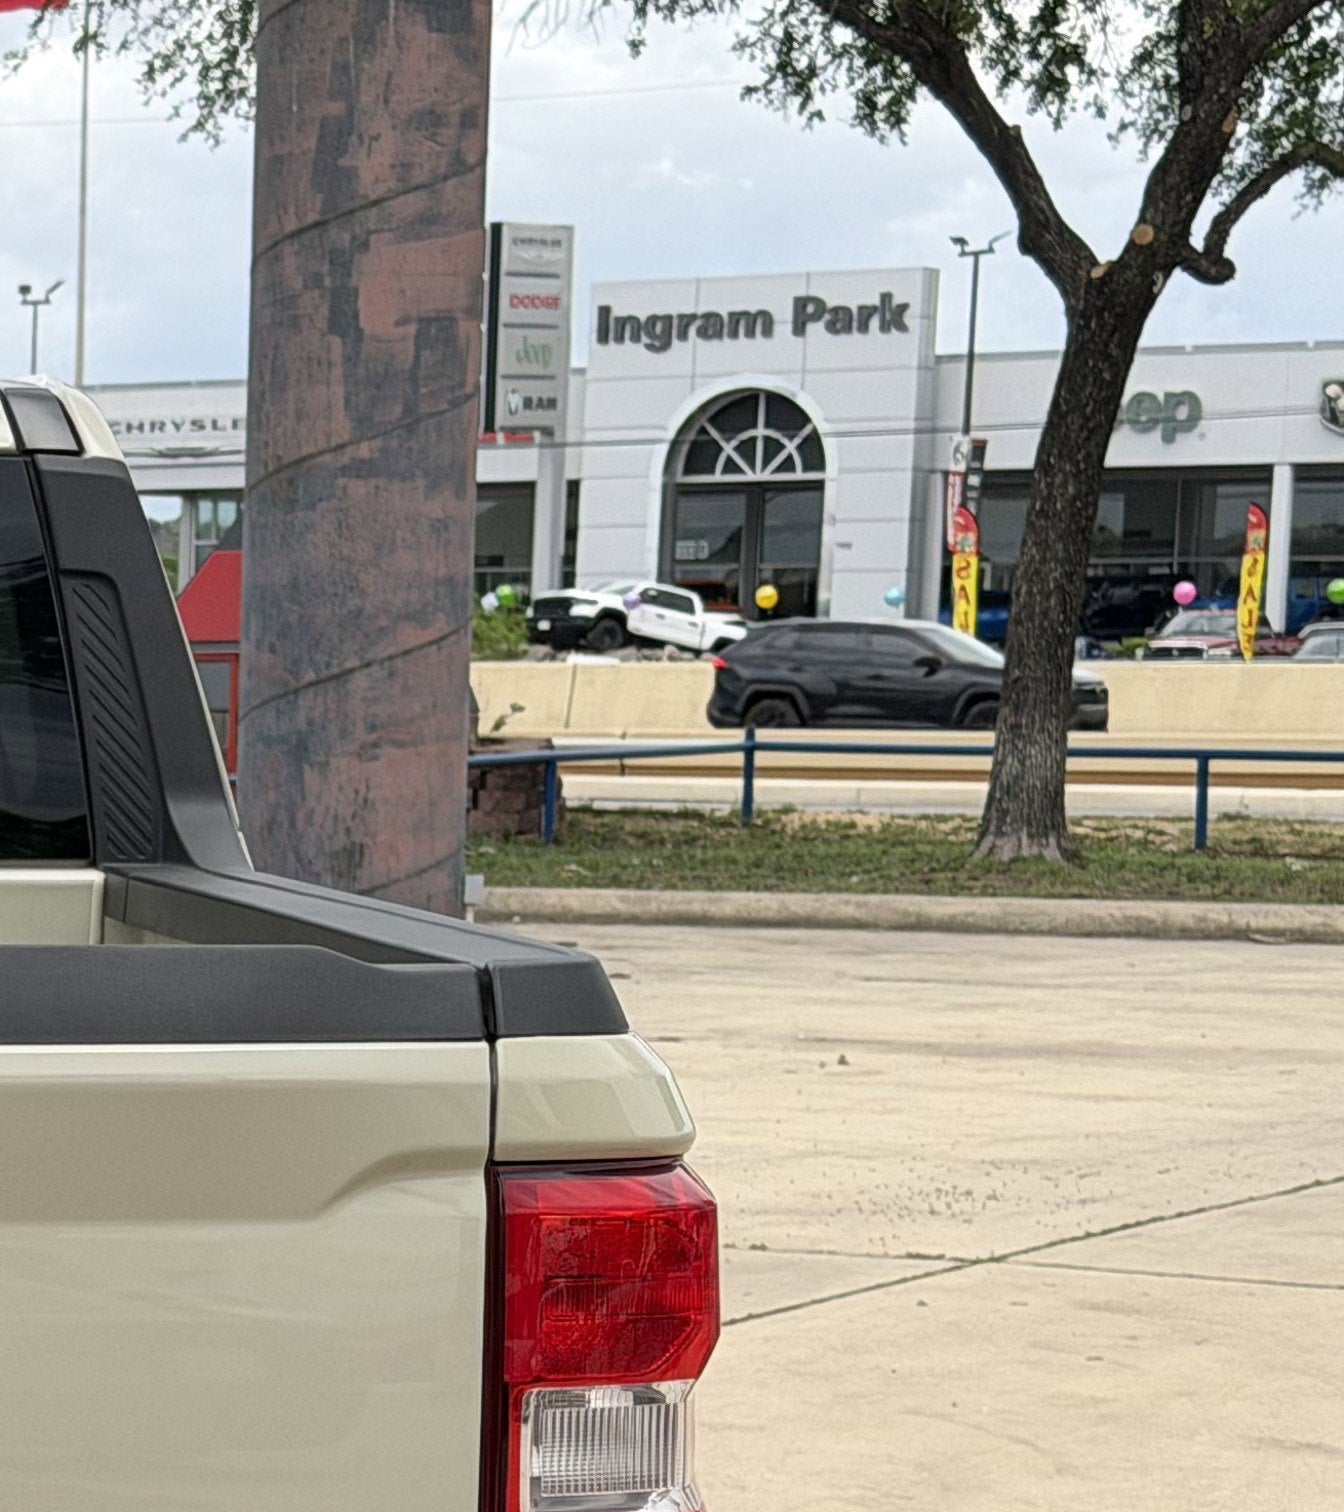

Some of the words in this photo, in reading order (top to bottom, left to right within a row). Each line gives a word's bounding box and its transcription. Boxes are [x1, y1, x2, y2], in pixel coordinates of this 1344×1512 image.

[509, 293, 562, 310] DODGE
[596, 304, 774, 353] Ingram
[792, 292, 910, 338] Park
